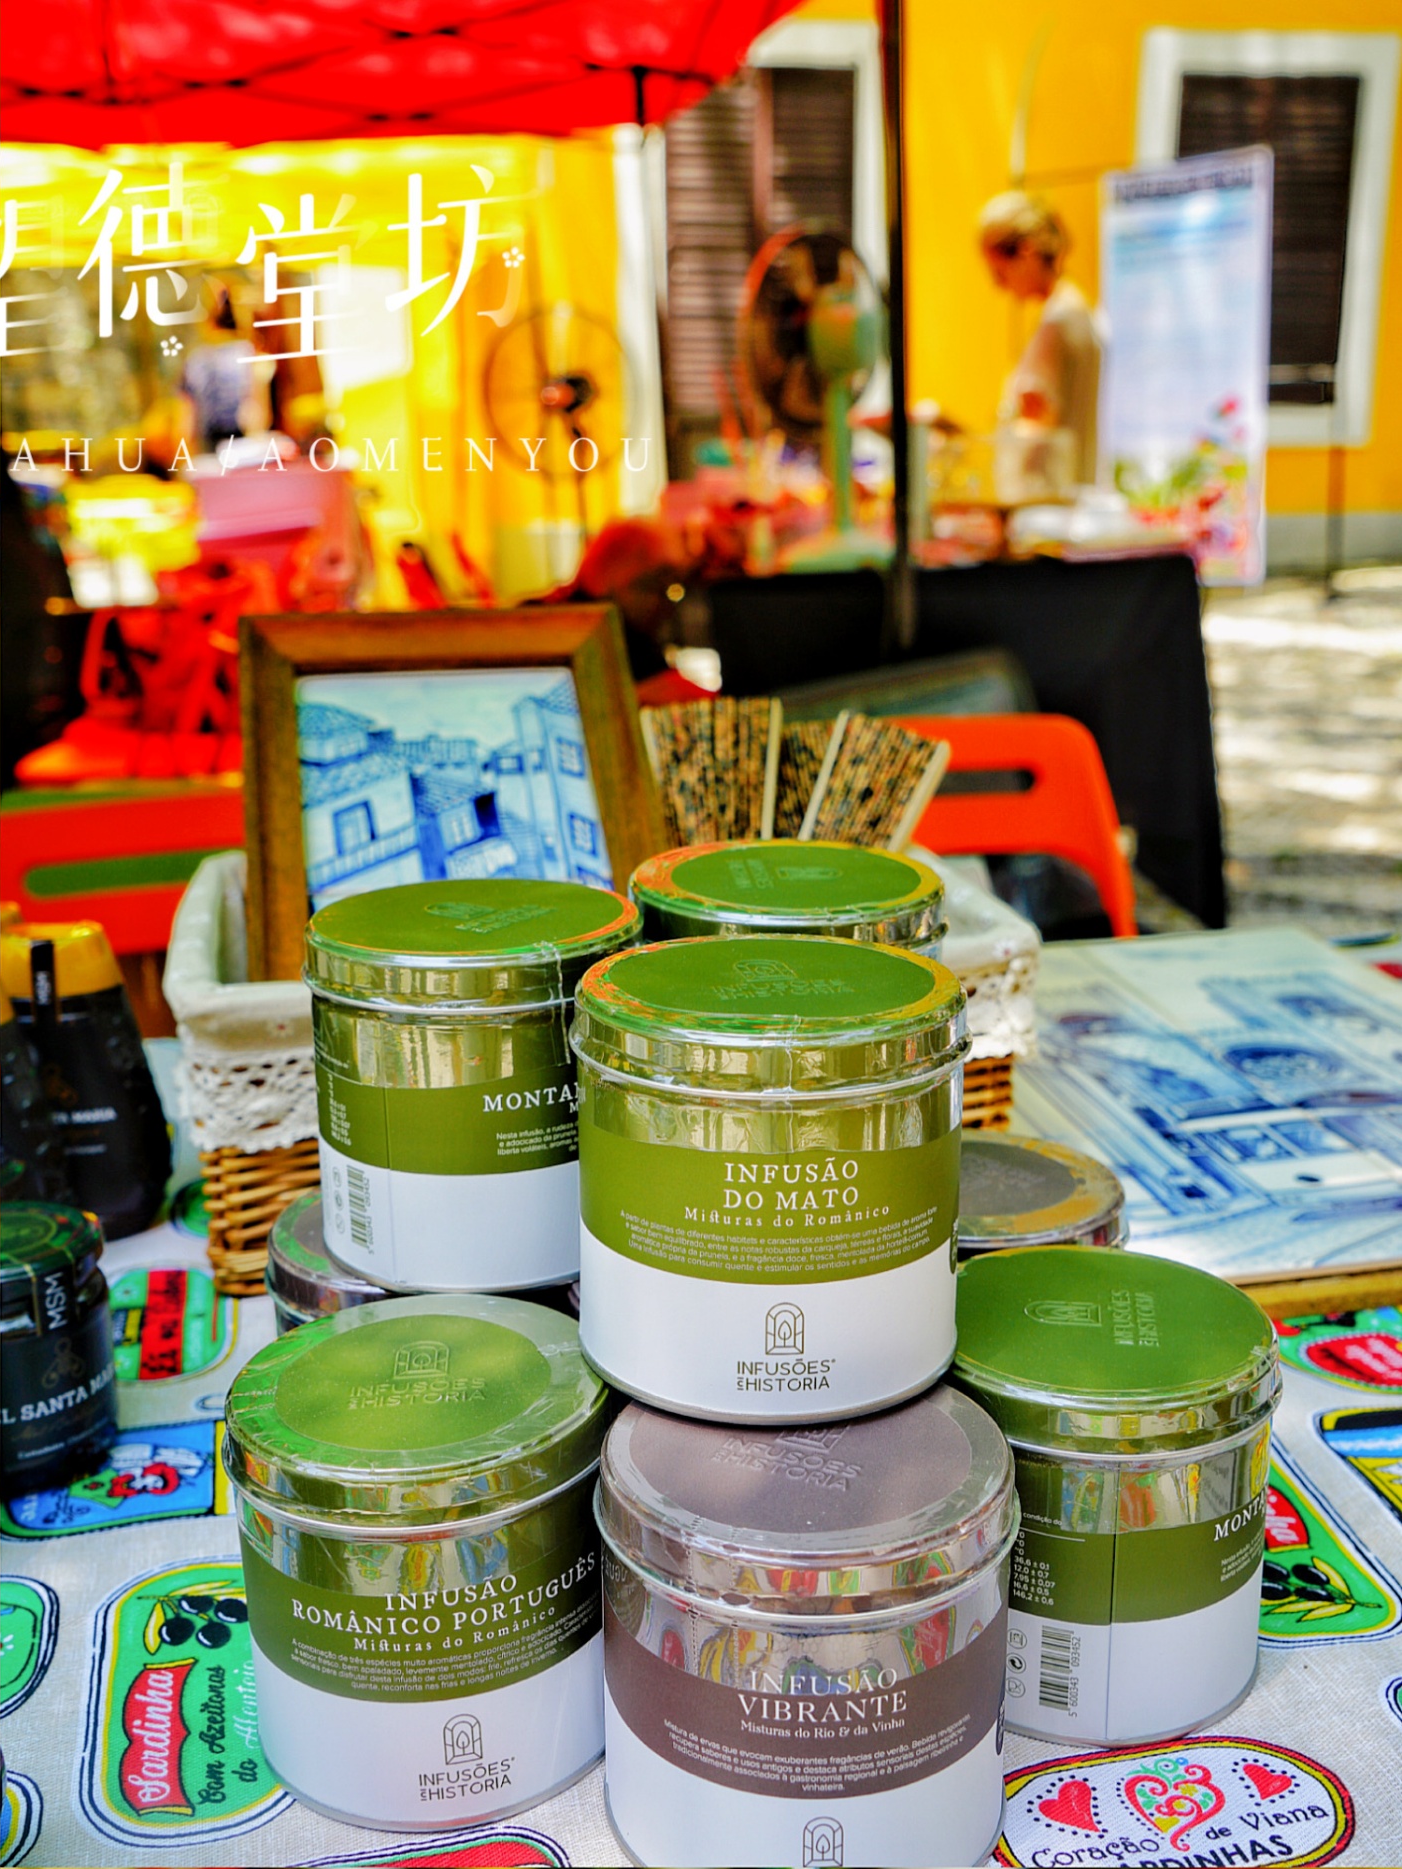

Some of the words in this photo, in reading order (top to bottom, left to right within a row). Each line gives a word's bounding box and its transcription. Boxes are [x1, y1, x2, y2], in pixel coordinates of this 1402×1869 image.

[724, 1156, 859, 1184] INFUSÃO
[723, 1189, 763, 1210] DO
[775, 1187, 859, 1211] MATO
[773, 1215, 794, 1227] do
[804, 1206, 890, 1227] Românico
[45, 1272, 68, 1331] MSM
[737, 1358, 831, 1376] INFUSÕES
[20, 1386, 88, 1421] SANTA
[291, 1599, 442, 1636] ROMÂNICO
[453, 1551, 596, 1631] PORTUGUÊS
[384, 1574, 517, 1612] INFUSÃO
[443, 1637, 464, 1649] do
[473, 1606, 556, 1644] Românico
[749, 1666, 898, 1697] INFUSÃO
[737, 1690, 908, 1724] VIBRANTE
[128, 1670, 174, 1803] Sardinha
[741, 1719, 791, 1738] Misturas
[794, 1727, 811, 1739] do
[814, 1726, 835, 1738] Rio
[854, 1723, 869, 1736] da
[872, 1717, 906, 1733] Vinha
[418, 1758, 511, 1787] INFUSÕES
[774, 1755, 828, 1765] exuberantes
[789, 1773, 843, 1784] gastronomia
[844, 1770, 878, 1782] regional
[1030, 1837, 1160, 1867] Coração
[1205, 1826, 1233, 1841] de
[1239, 1802, 1329, 1831] Viana
